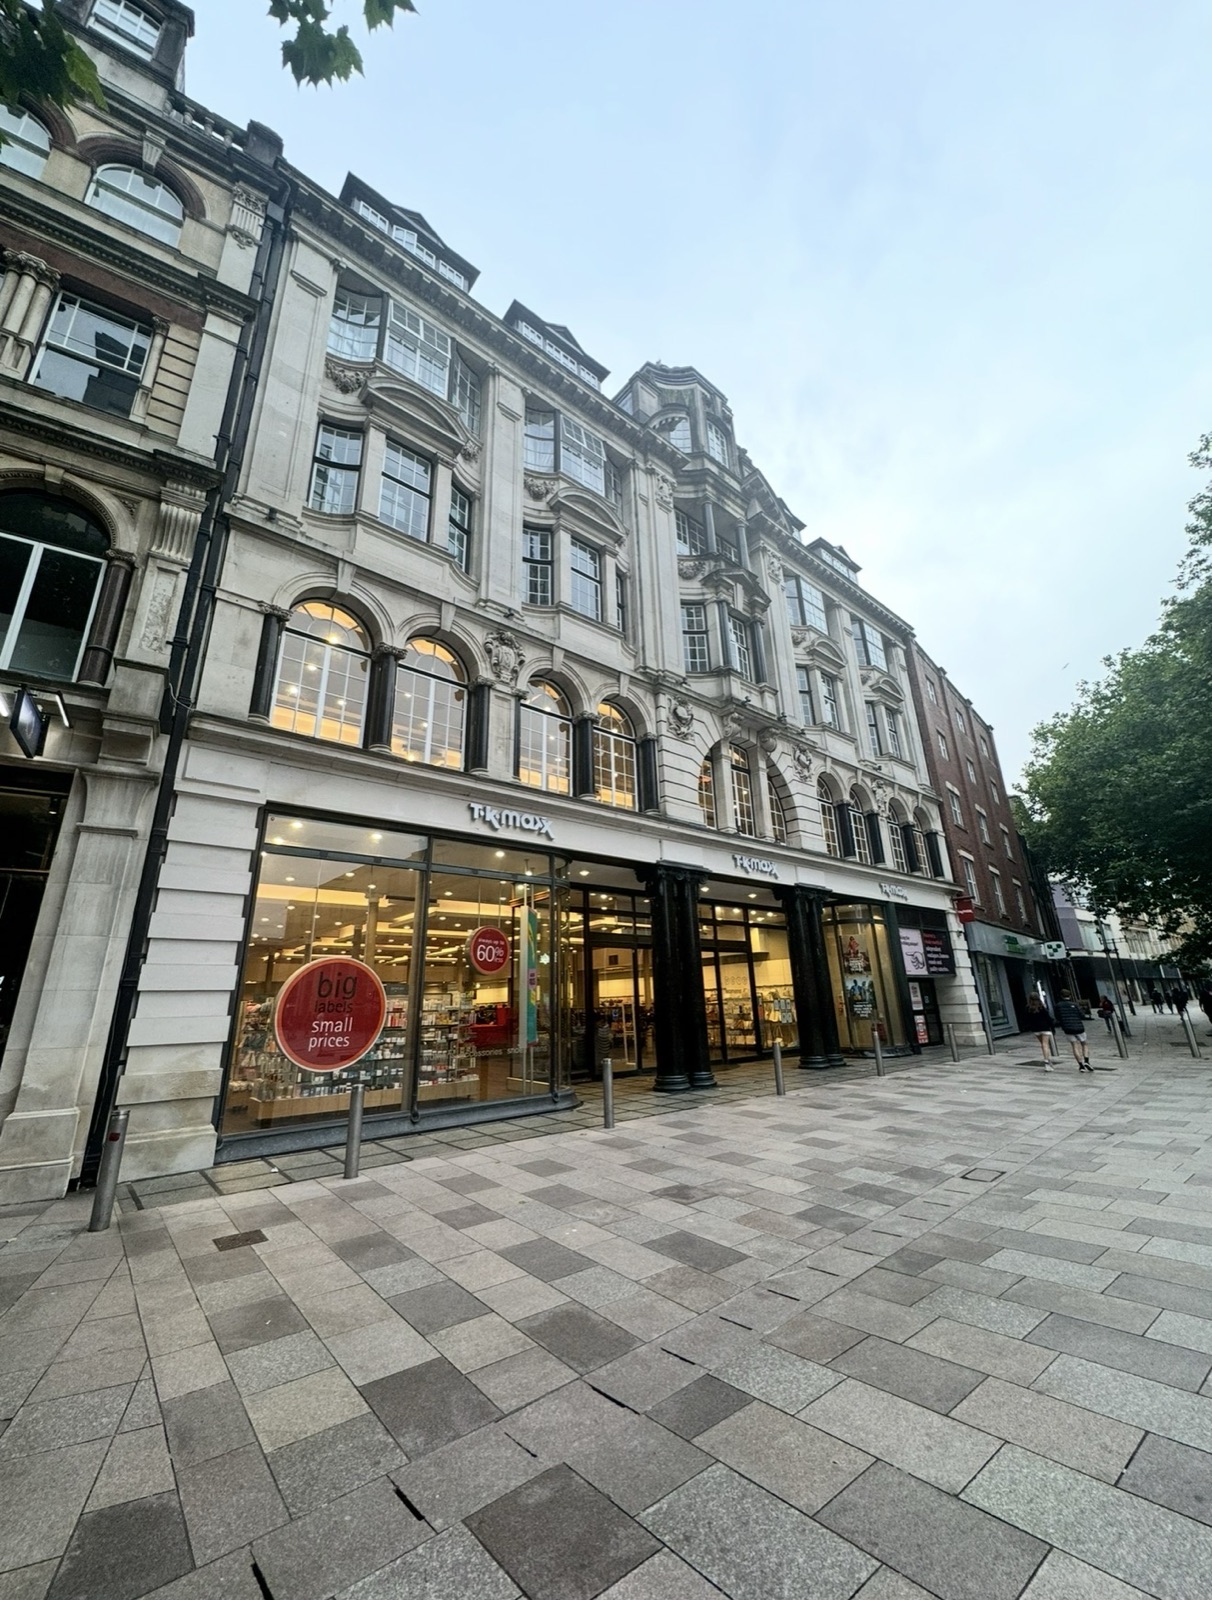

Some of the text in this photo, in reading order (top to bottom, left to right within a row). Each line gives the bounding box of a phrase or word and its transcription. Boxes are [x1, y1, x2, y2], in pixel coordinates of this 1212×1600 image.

[317, 972, 358, 1000] big
[314, 1000, 353, 1014] labels
[311, 1017, 353, 1033] small
[308, 1033, 350, 1052] prices
